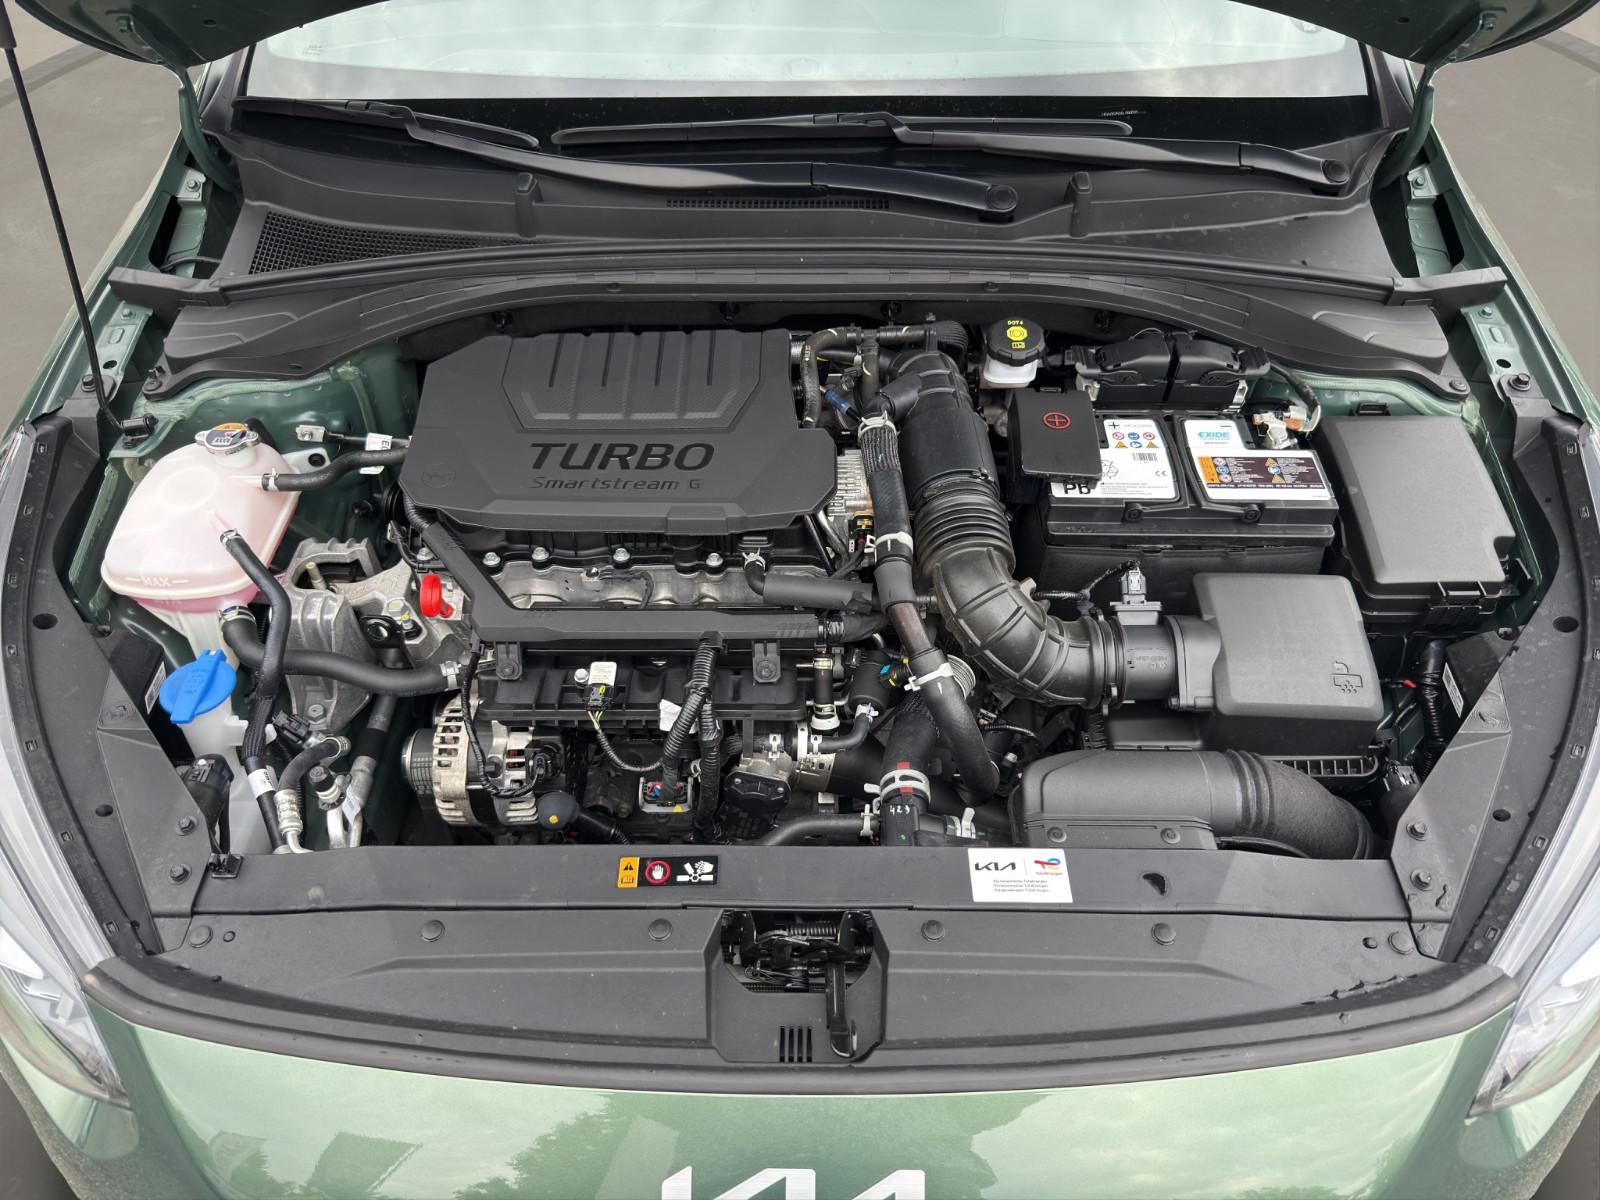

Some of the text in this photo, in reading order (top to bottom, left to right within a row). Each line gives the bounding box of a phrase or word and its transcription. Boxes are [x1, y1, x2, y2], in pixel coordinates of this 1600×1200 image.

[530, 443, 715, 471] TURBO
[530, 476, 702, 490] Smartstream G
[141, 577, 171, 587] MAX
[975, 862, 1016, 871] KIA
